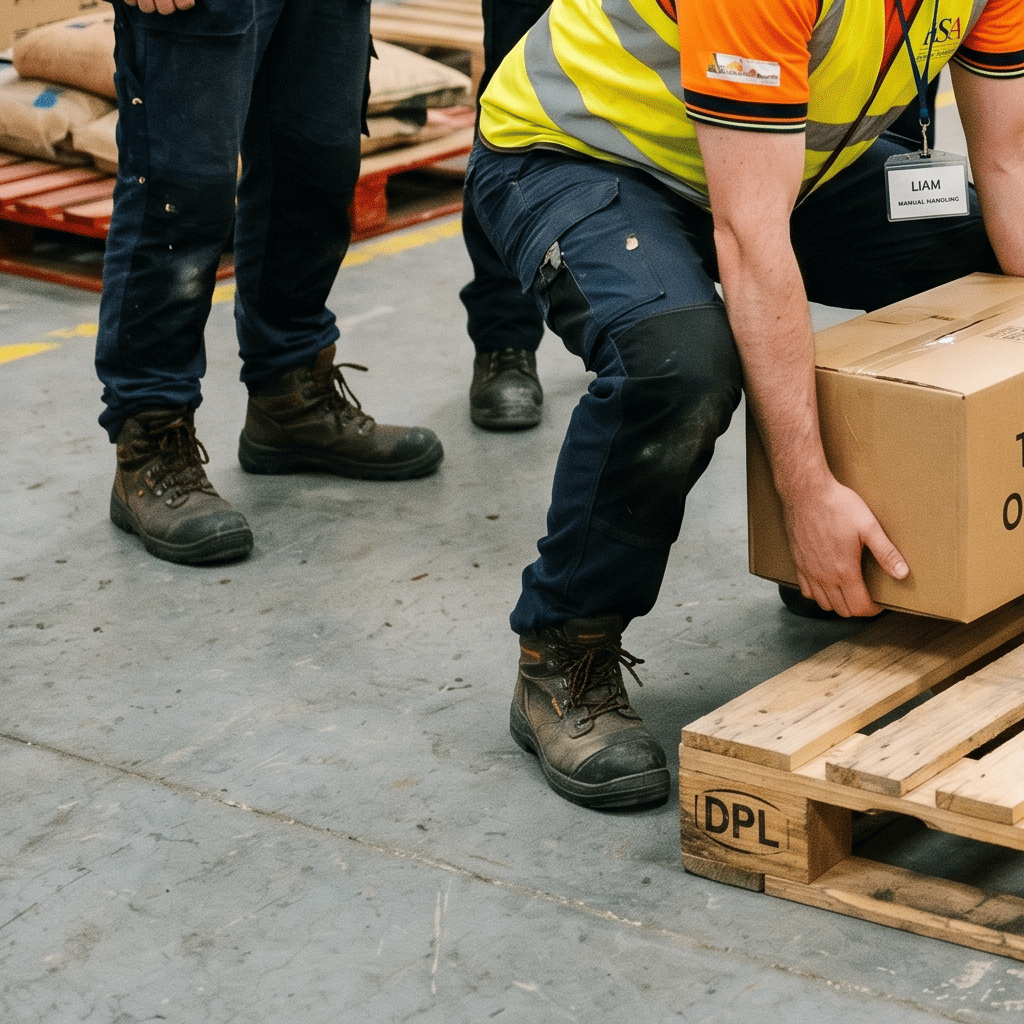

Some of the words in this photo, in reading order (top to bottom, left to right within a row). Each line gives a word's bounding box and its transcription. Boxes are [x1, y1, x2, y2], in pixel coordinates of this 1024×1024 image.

[912, 179, 941, 192] LIAM
[898, 199, 926, 207] MANUAL
[705, 795, 779, 849] DPL
